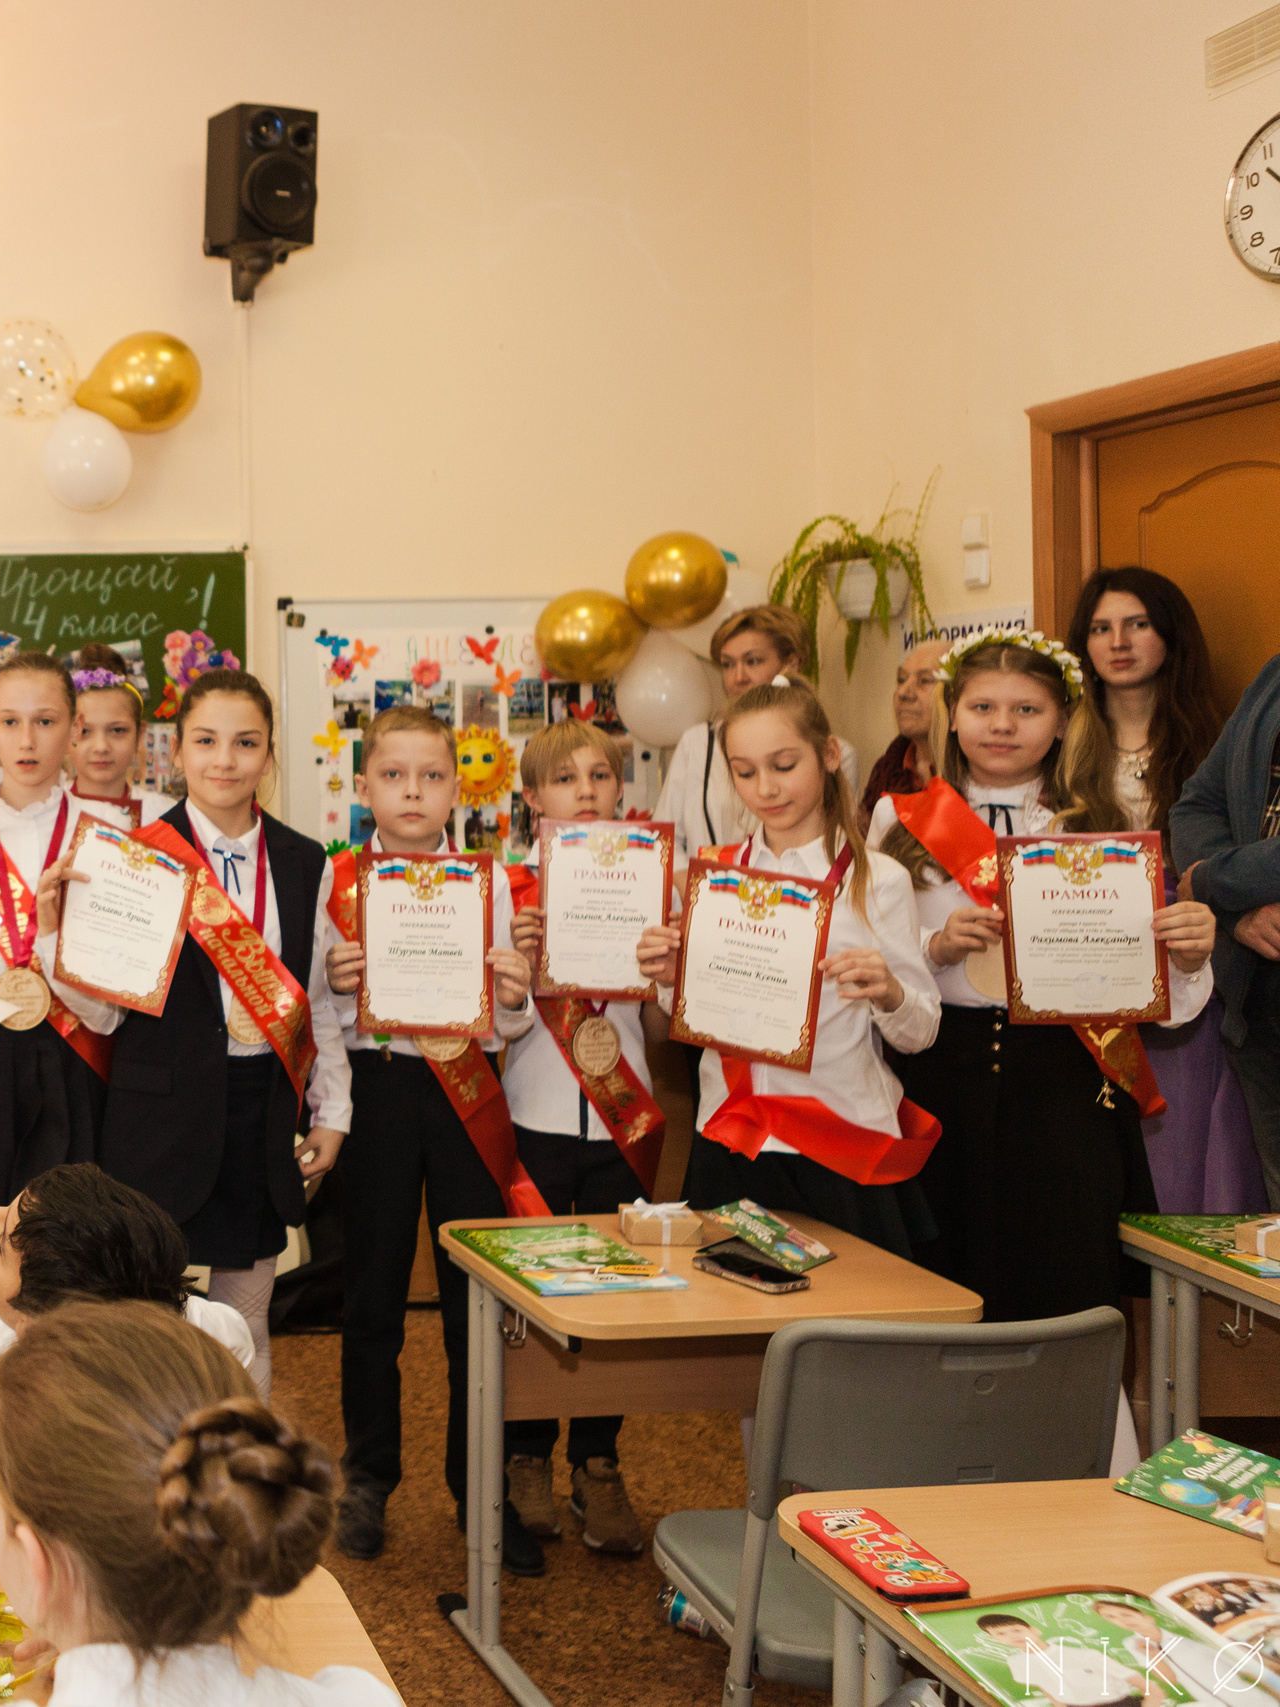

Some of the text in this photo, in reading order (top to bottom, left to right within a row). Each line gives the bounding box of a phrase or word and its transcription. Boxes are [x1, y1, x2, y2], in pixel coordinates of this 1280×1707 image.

[1262, 142, 1274, 161] 11
[1245, 172, 1261, 191] 10
[1239, 204, 1254, 221] 9
[1249, 231, 1265, 248] 8
[22, 600, 49, 642] 4
[99, 859, 162, 892] ГРАМОТА
[573, 869, 638, 883] ГРАМОТА
[1041, 888, 1121, 901] ГРАМОТА
[390, 903, 457, 916] ГРАМОТА
[604, 911, 648, 926] Александр
[716, 916, 788, 943] ГРАМОТА
[1080, 934, 1140, 946] Александра
[428, 947, 464, 958] Матвей
[198, 926, 272, 1018] начальной
[708, 961, 753, 979] Смирнова
[754, 970, 789, 987] Ксения
